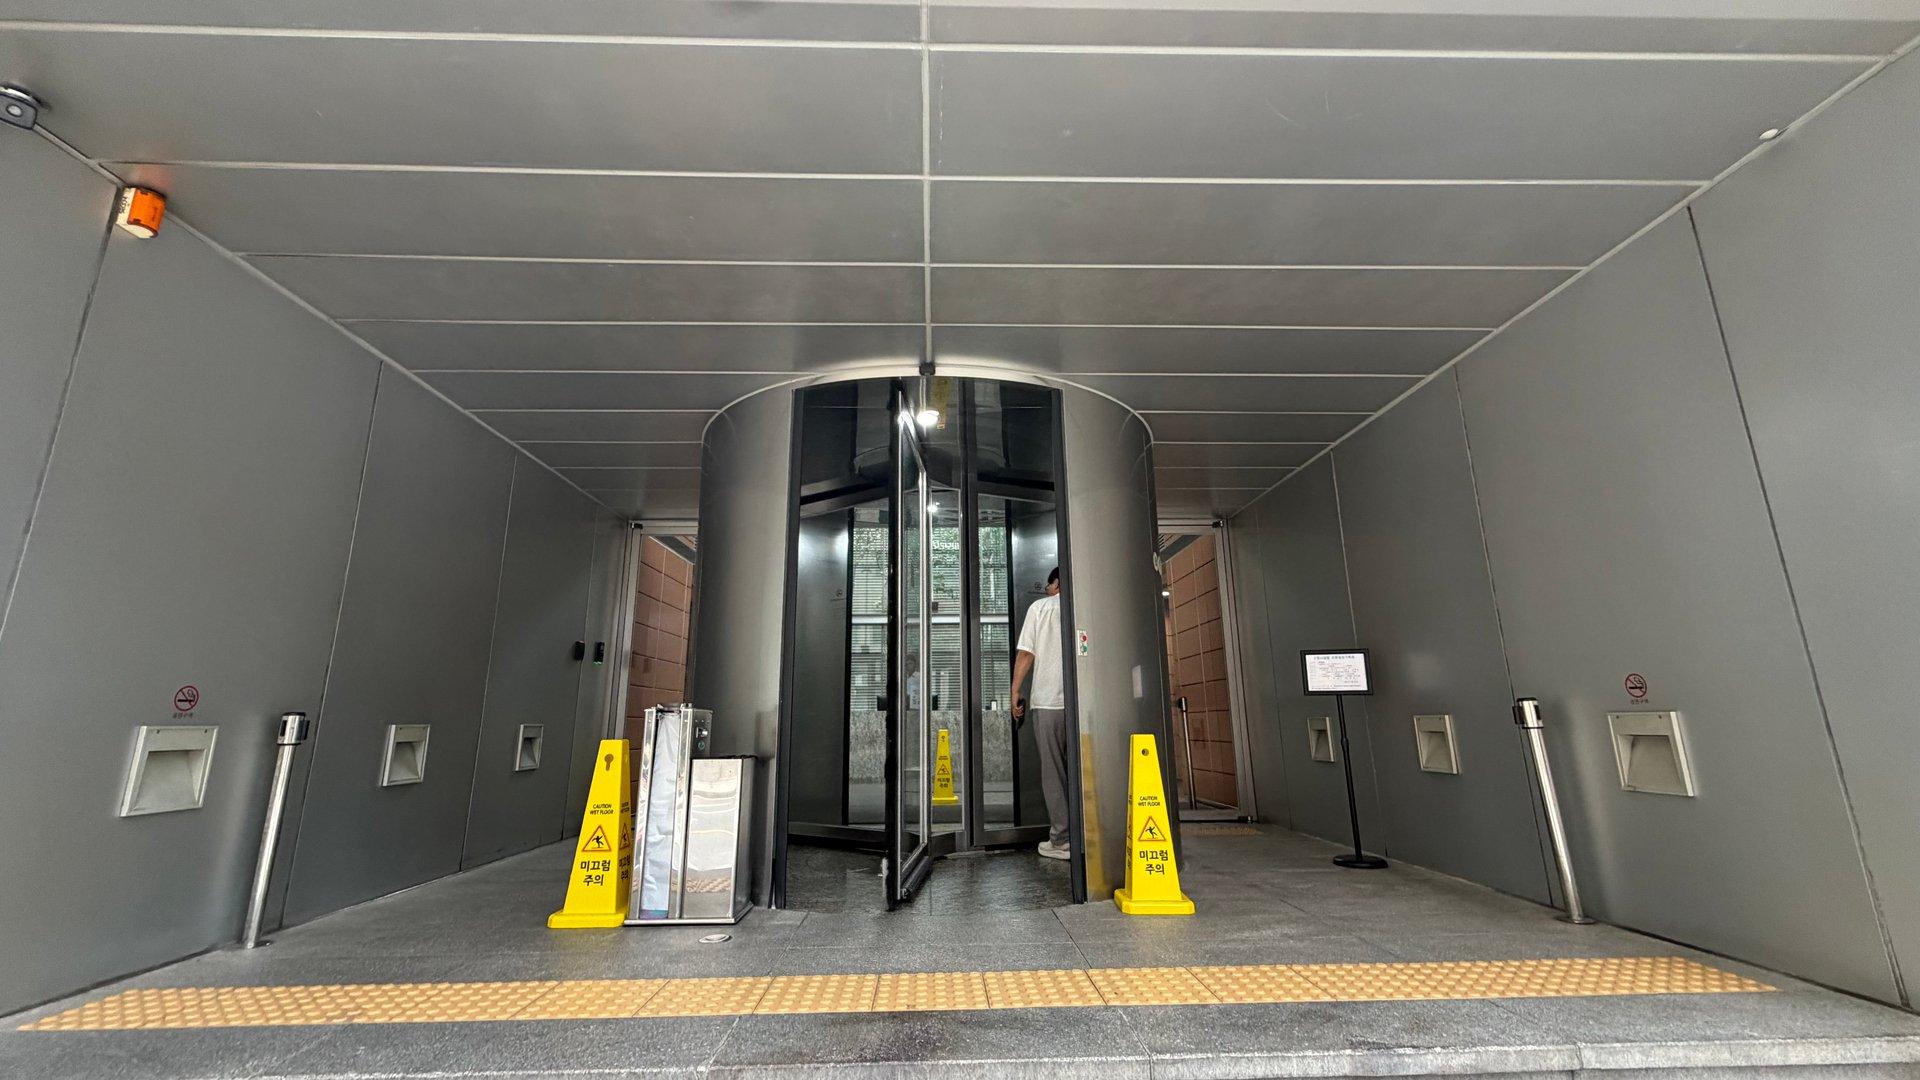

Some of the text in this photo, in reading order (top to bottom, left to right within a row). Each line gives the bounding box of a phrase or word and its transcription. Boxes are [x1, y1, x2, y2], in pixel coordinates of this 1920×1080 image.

[1139, 849, 1168, 861] 미끄럼
[580, 860, 611, 872] 미끄럼
[1145, 863, 1165, 875] 주의
[583, 874, 604, 886] 주의
